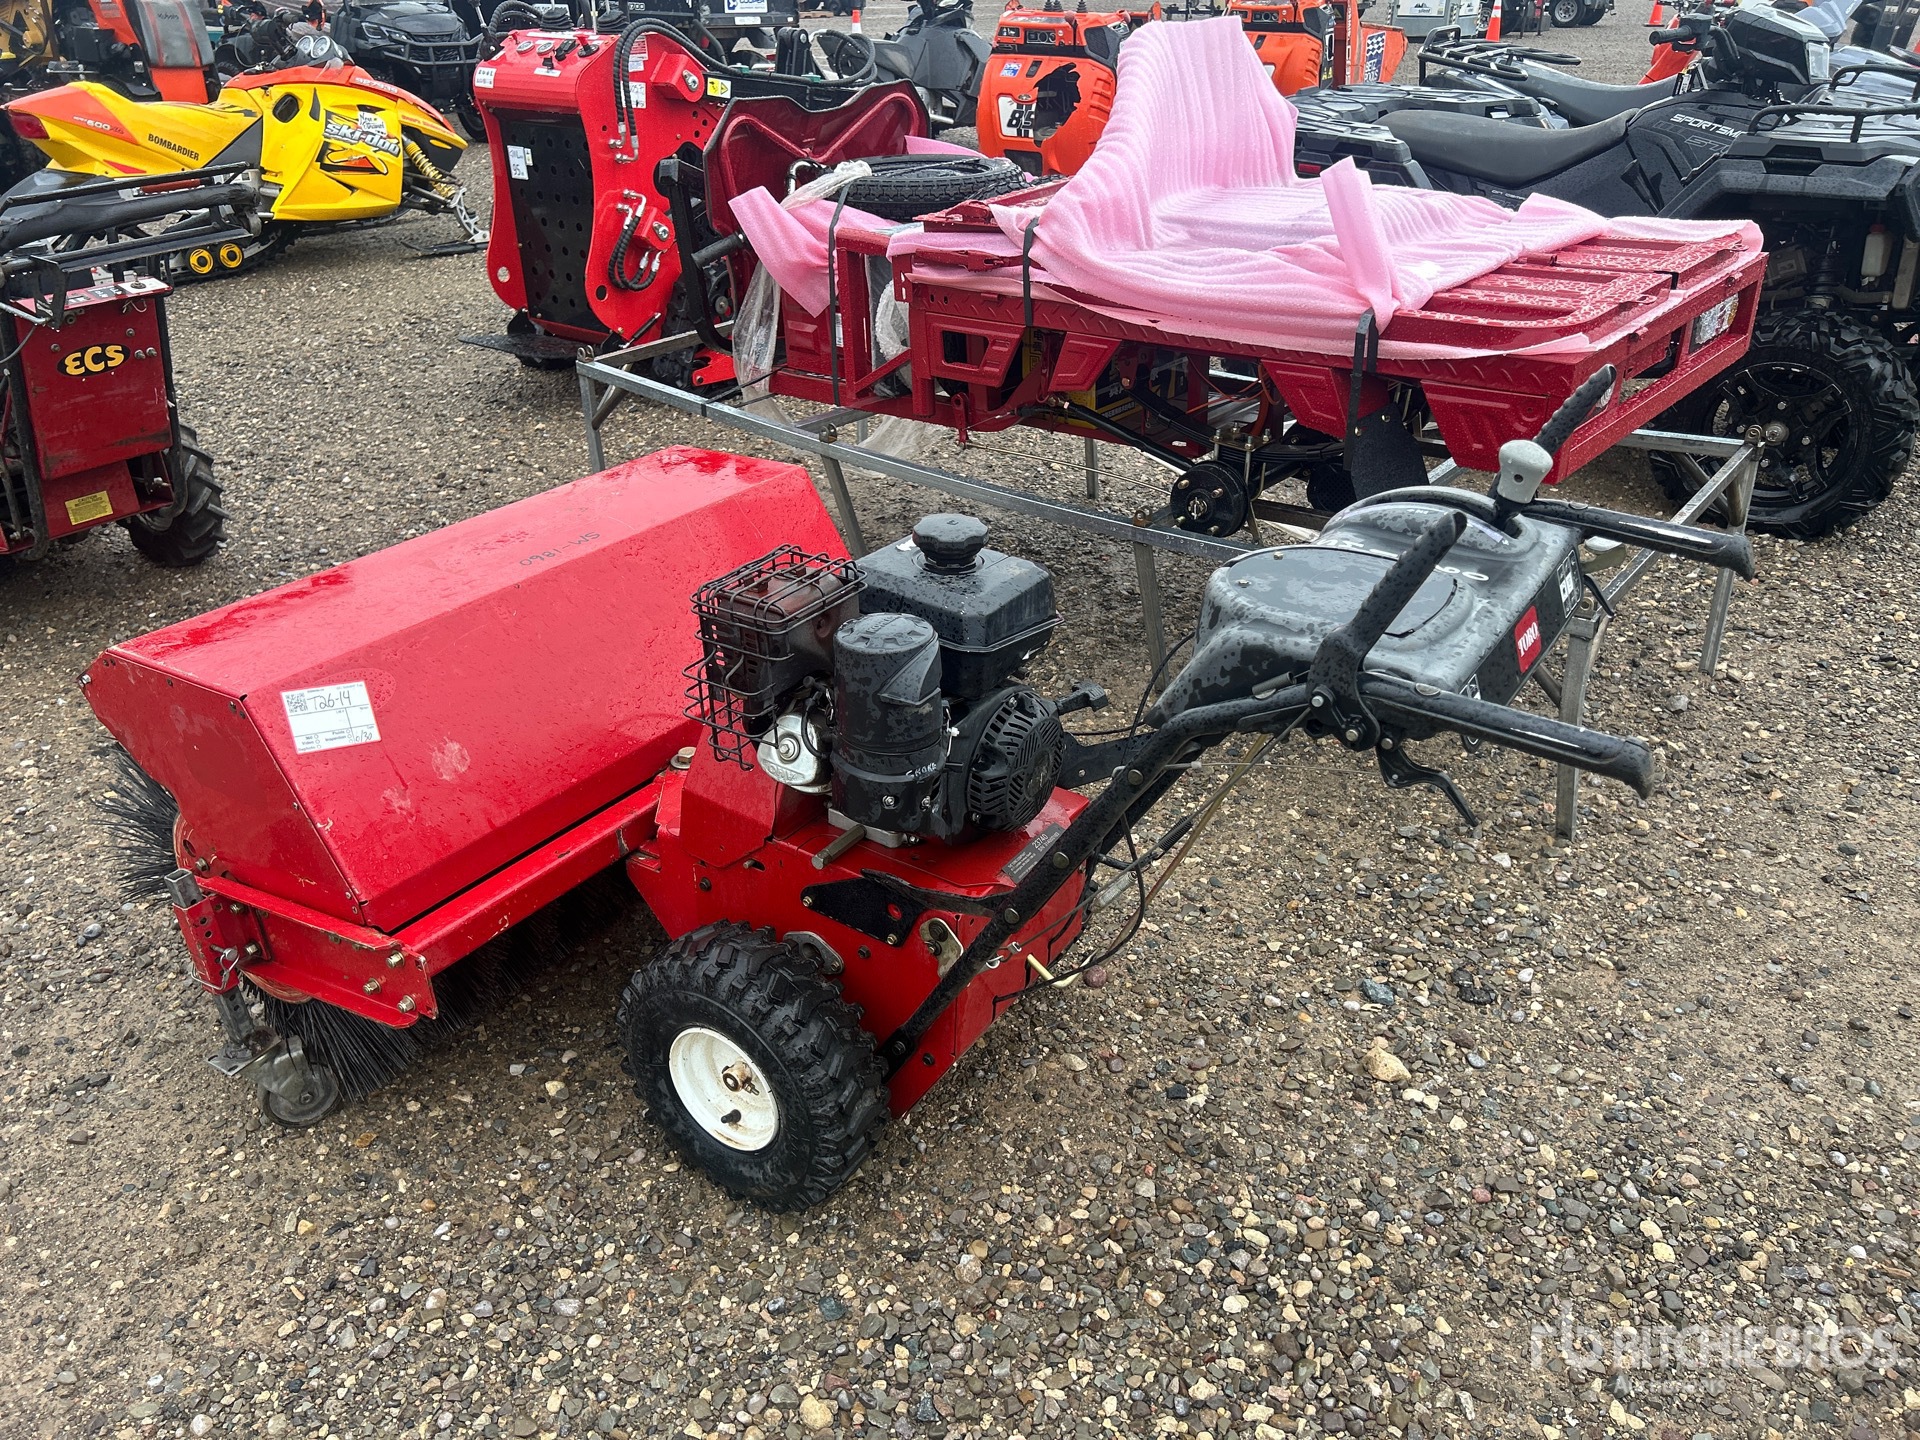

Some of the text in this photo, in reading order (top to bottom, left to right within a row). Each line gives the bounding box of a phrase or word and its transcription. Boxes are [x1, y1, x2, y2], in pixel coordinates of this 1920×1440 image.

[147, 133, 200, 161] BOMBARDIER
[64, 345, 125, 376] ECS
[1517, 621, 1540, 658] TORO
[306, 689, 352, 711] T26-14
